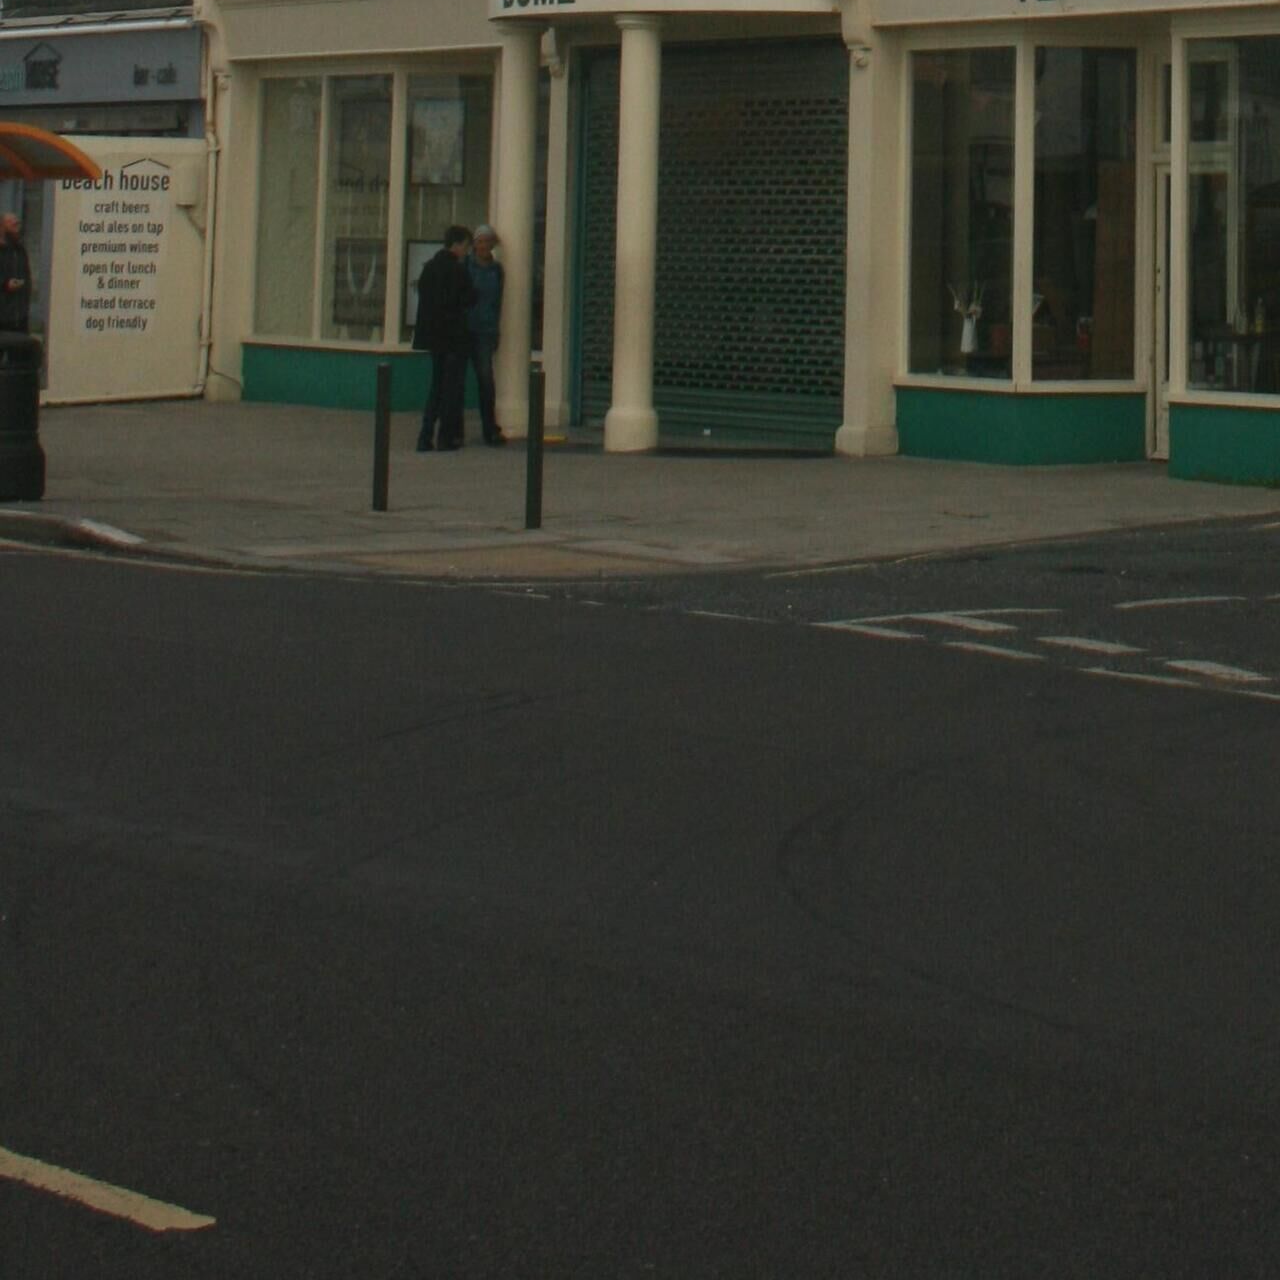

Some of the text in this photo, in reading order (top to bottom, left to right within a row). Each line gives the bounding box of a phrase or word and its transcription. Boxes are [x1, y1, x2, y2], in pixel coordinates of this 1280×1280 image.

[120, 169, 170, 190] house
[94, 200, 149, 213] craft beers
[79, 221, 164, 236] local ales on tap
[81, 240, 159, 256] premium wines
[83, 261, 156, 276] open for lunch
[97, 277, 140, 289] & dinner
[80, 297, 155, 310] heated terrace
[86, 316, 147, 332] dog friendly
